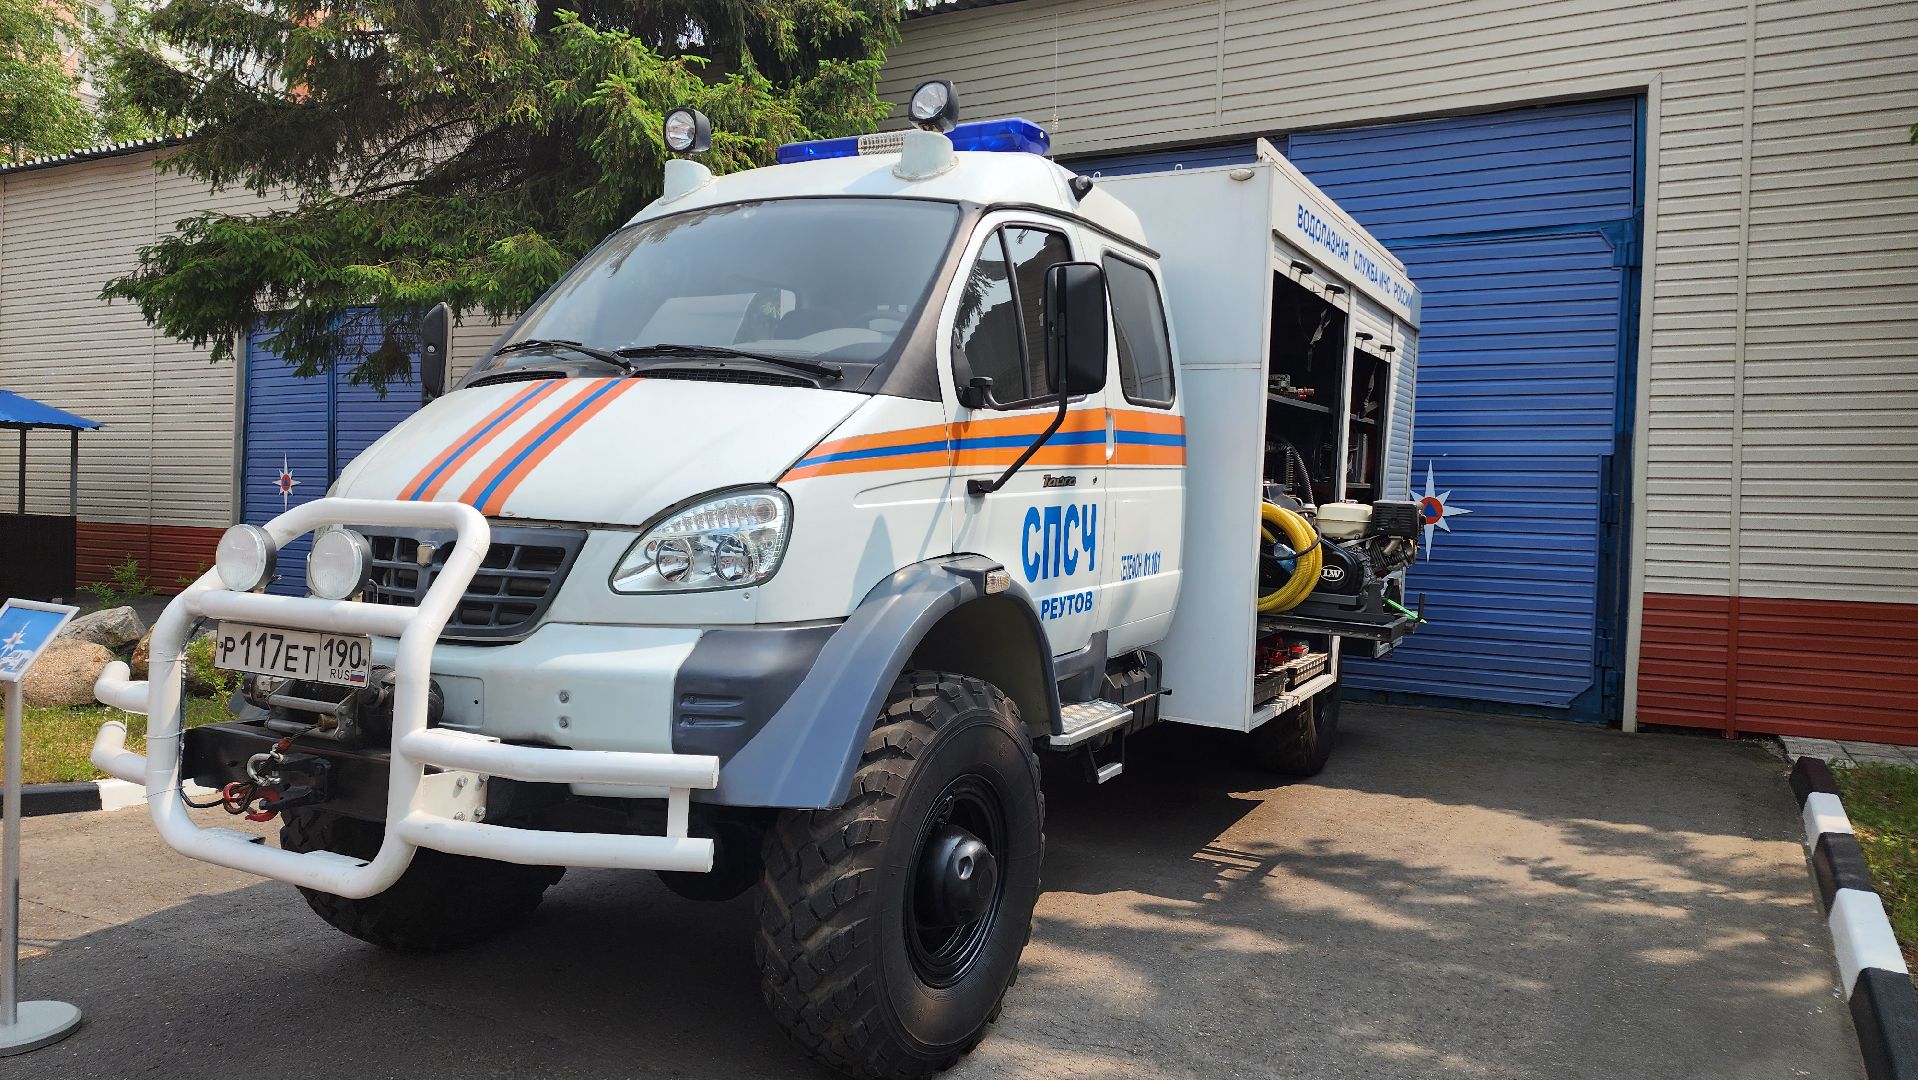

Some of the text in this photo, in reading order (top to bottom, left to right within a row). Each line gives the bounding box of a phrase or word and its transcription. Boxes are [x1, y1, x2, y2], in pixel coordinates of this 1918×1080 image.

[1298, 204, 1349, 263] ВОДОЛАЗНАЯ
[1354, 250, 1378, 285] СЛУЖБА
[1022, 504, 1097, 583] СПСЧ
[1041, 591, 1093, 621] РЕУТОВ
[323, 638, 362, 669] 190
[330, 669, 350, 680] RUS
